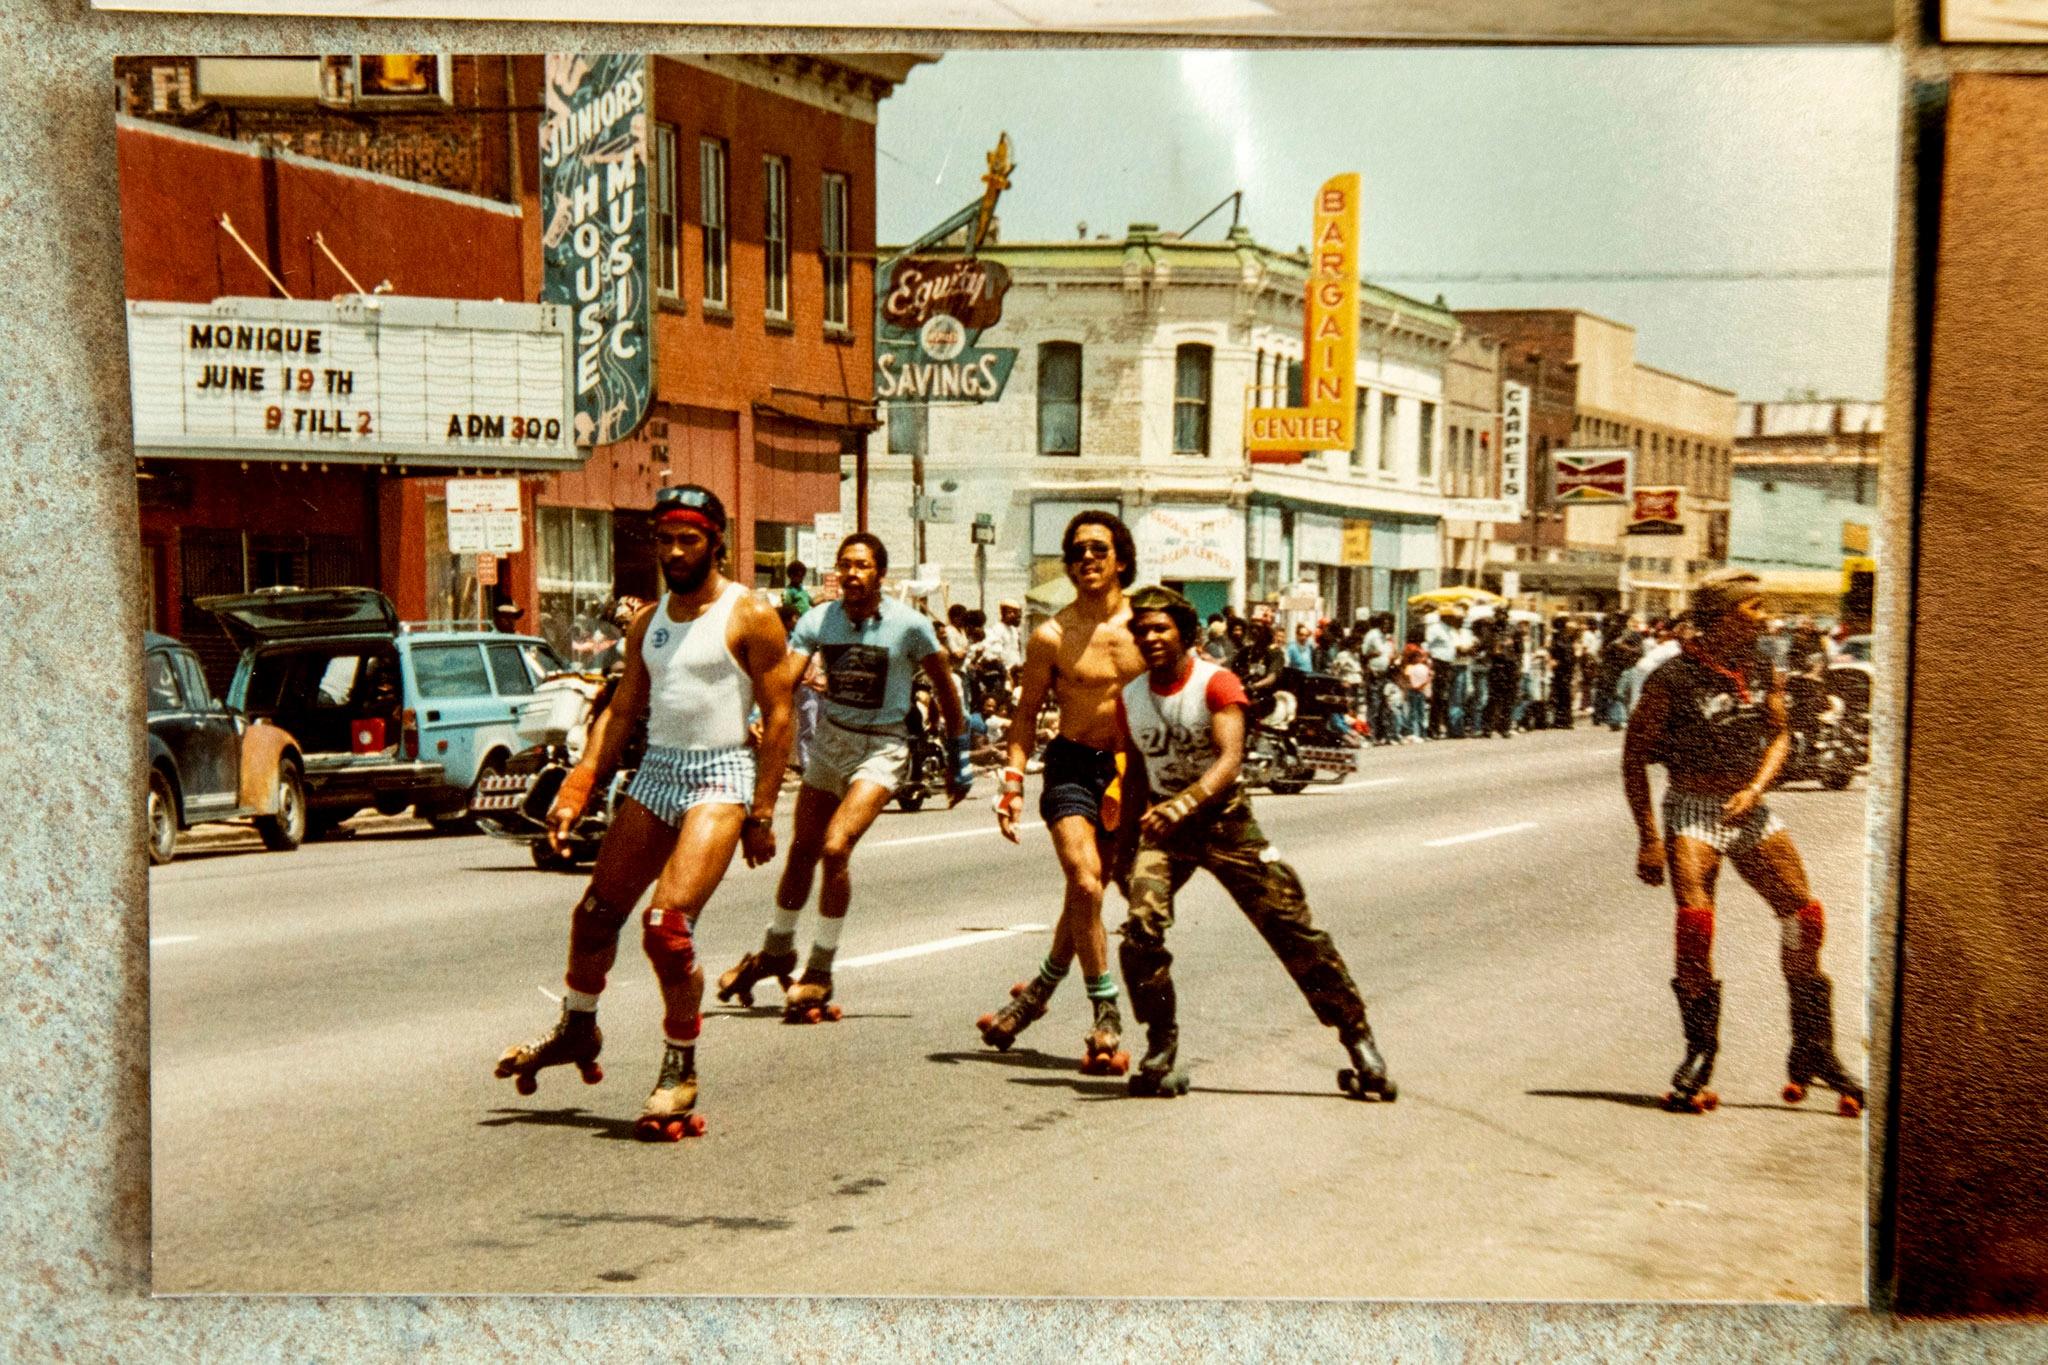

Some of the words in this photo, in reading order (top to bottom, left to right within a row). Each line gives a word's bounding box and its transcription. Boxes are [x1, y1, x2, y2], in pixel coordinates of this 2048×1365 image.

[607, 148, 636, 359] MUSIC
[573, 172, 603, 396] HOUSE
[887, 264, 986, 321] Equity
[1316, 189, 1346, 401] BARGAIN
[190, 324, 322, 353] MONIQUE
[197, 365, 265, 391] JUNE
[878, 353, 998, 396] SAVINGS
[264, 405, 283, 430] 9
[294, 408, 352, 433] TILL
[357, 411, 373, 434] 2
[447, 414, 505, 439] ADM
[511, 415, 560, 440] 300
[1253, 416, 1343, 441] CENTER
[1504, 389, 1521, 495] CARPETS
